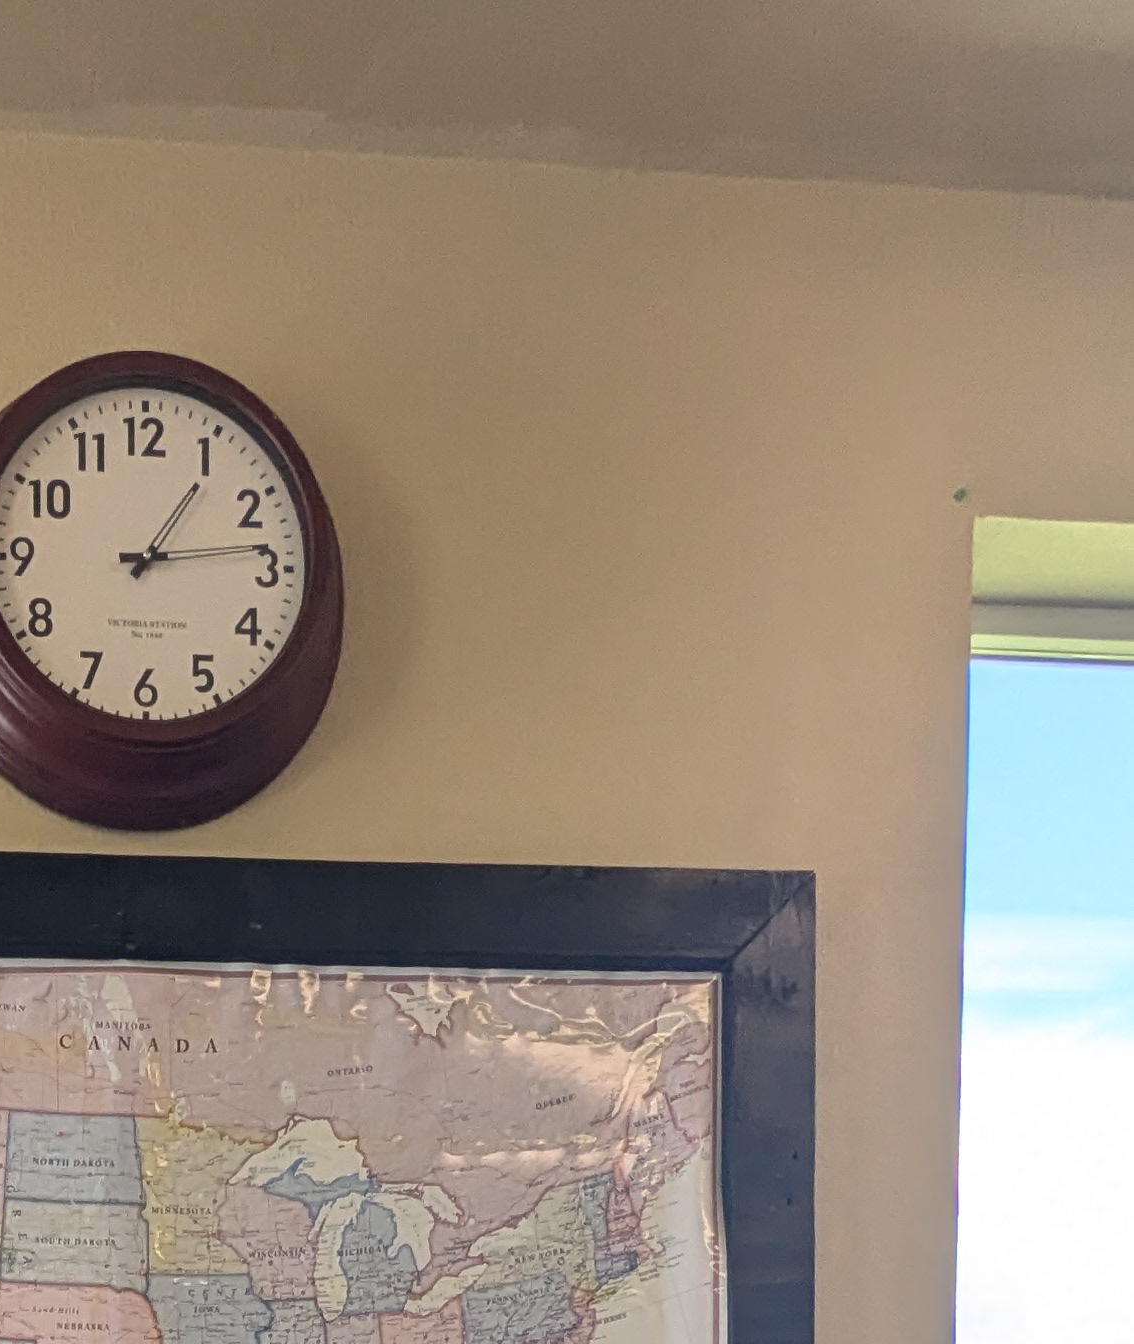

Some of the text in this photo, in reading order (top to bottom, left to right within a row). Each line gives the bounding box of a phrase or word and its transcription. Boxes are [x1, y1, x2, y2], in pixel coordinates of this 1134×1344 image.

[73, 431, 105, 472] 11
[123, 416, 166, 457] 12
[197, 437, 210, 477] 1
[29, 479, 71, 518] 10
[237, 488, 263, 528] 2
[9, 536, 34, 576] 9
[254, 547, 279, 588] 3
[28, 597, 53, 637] 8
[235, 607, 262, 646] 4
[80, 651, 103, 689] 7
[133, 669, 158, 707] 6
[192, 654, 215, 693] 5
[59, 1034, 218, 1054] CANADA
[95, 1020, 151, 1031] MANITOBA
[326, 1065, 374, 1078] ONTARIO
[32, 1157, 115, 1168] NORTH DAKOTA
[151, 1206, 212, 1216] MINNESOTA
[249, 1247, 306, 1259] WISCONSIN
[56, 1322, 110, 1334] NEBRASKA
[194, 1306, 220, 1314] IOWA
